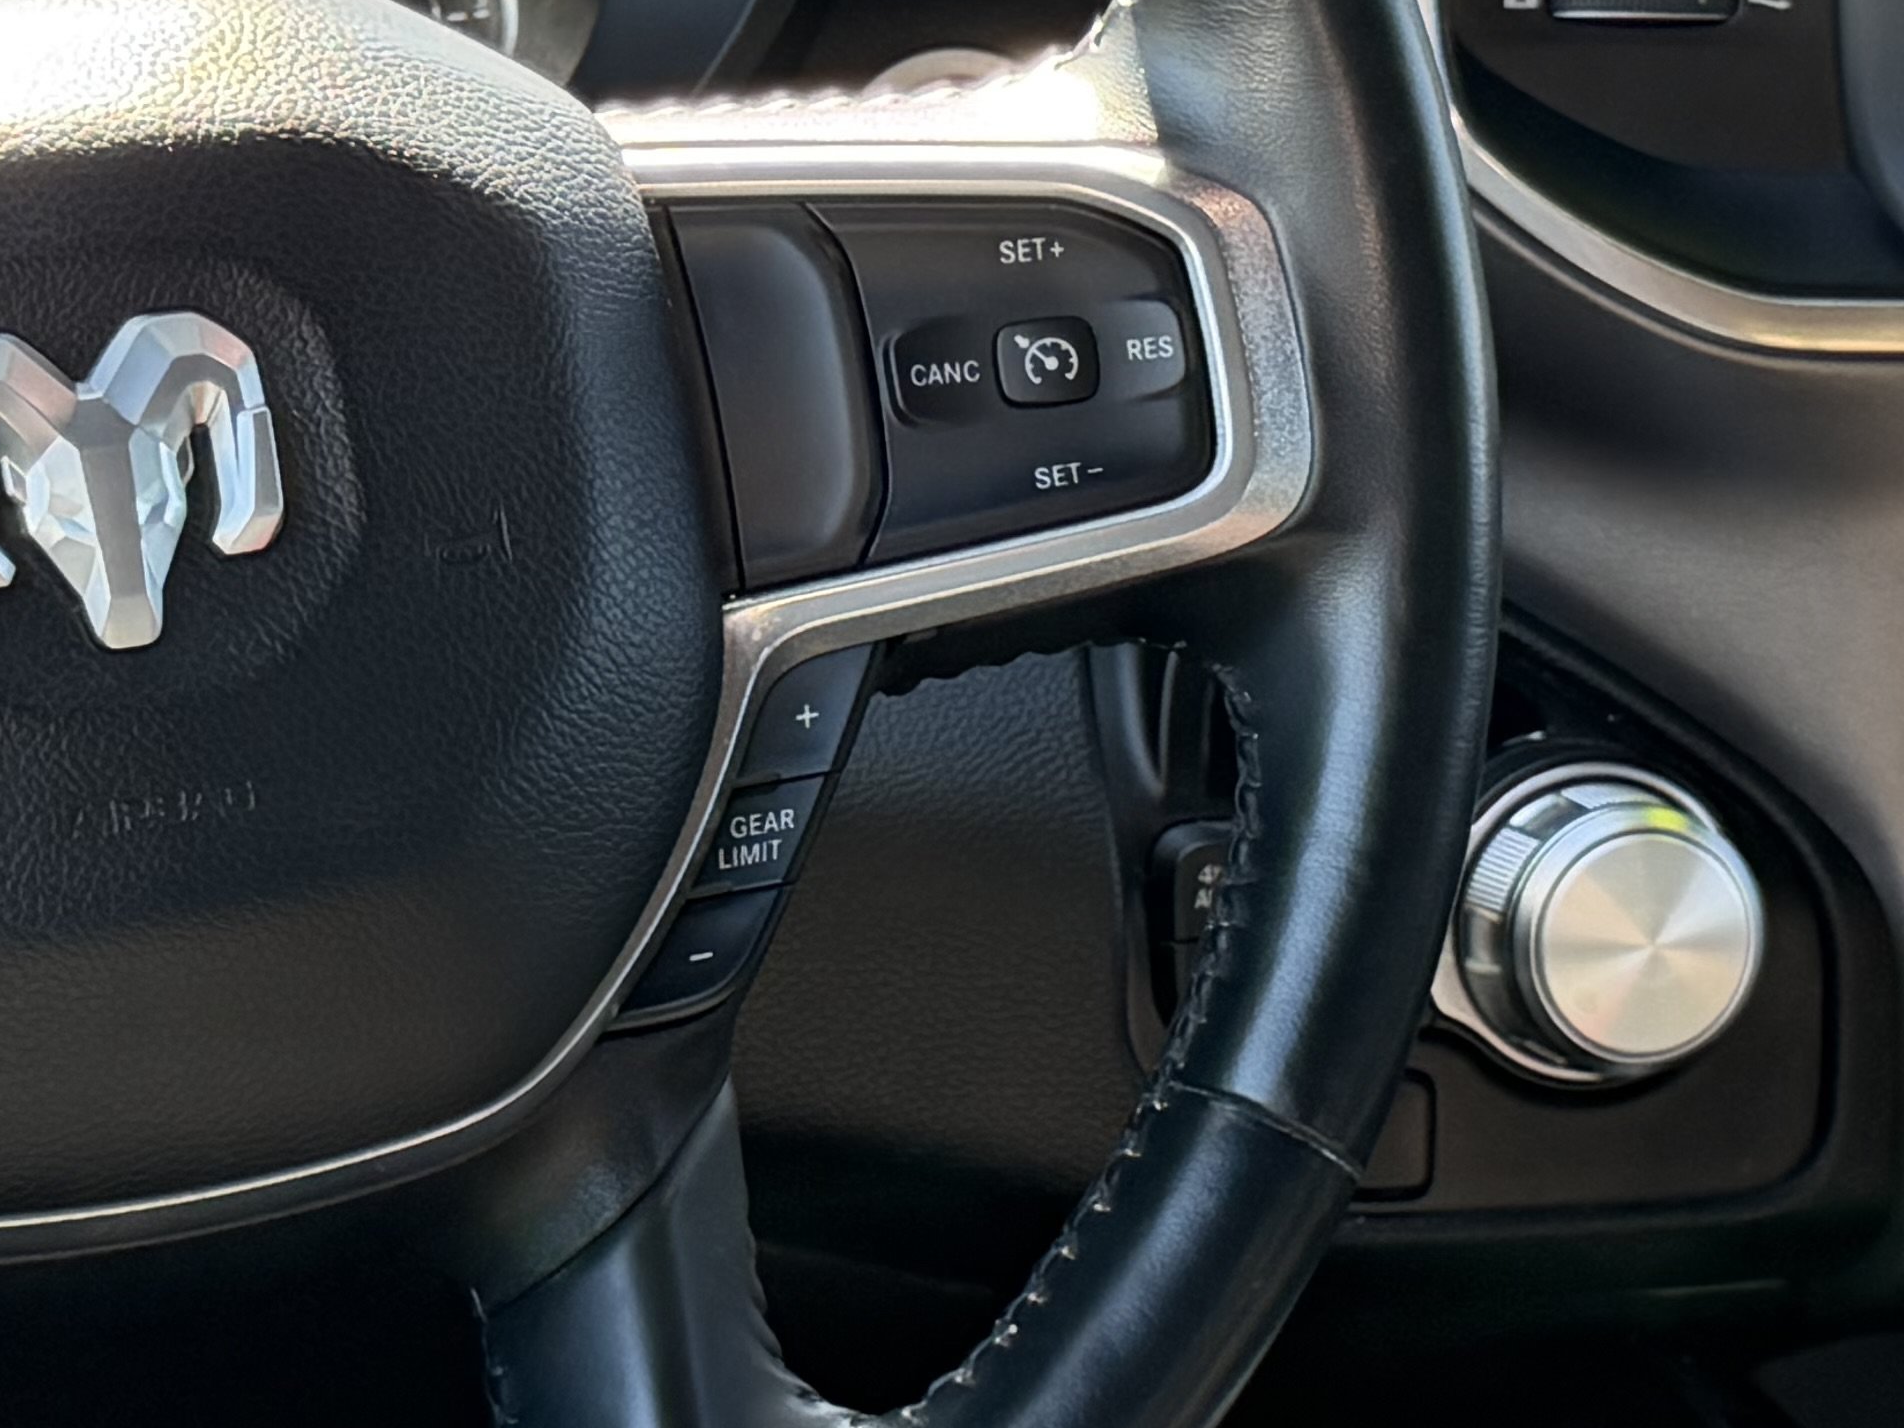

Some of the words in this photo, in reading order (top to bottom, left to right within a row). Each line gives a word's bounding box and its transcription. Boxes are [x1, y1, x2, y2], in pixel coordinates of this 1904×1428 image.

[1126, 336, 1174, 361] RES
[909, 360, 981, 387] CANC
[729, 808, 796, 839] GEAR
[717, 839, 783, 870] LIMIT
